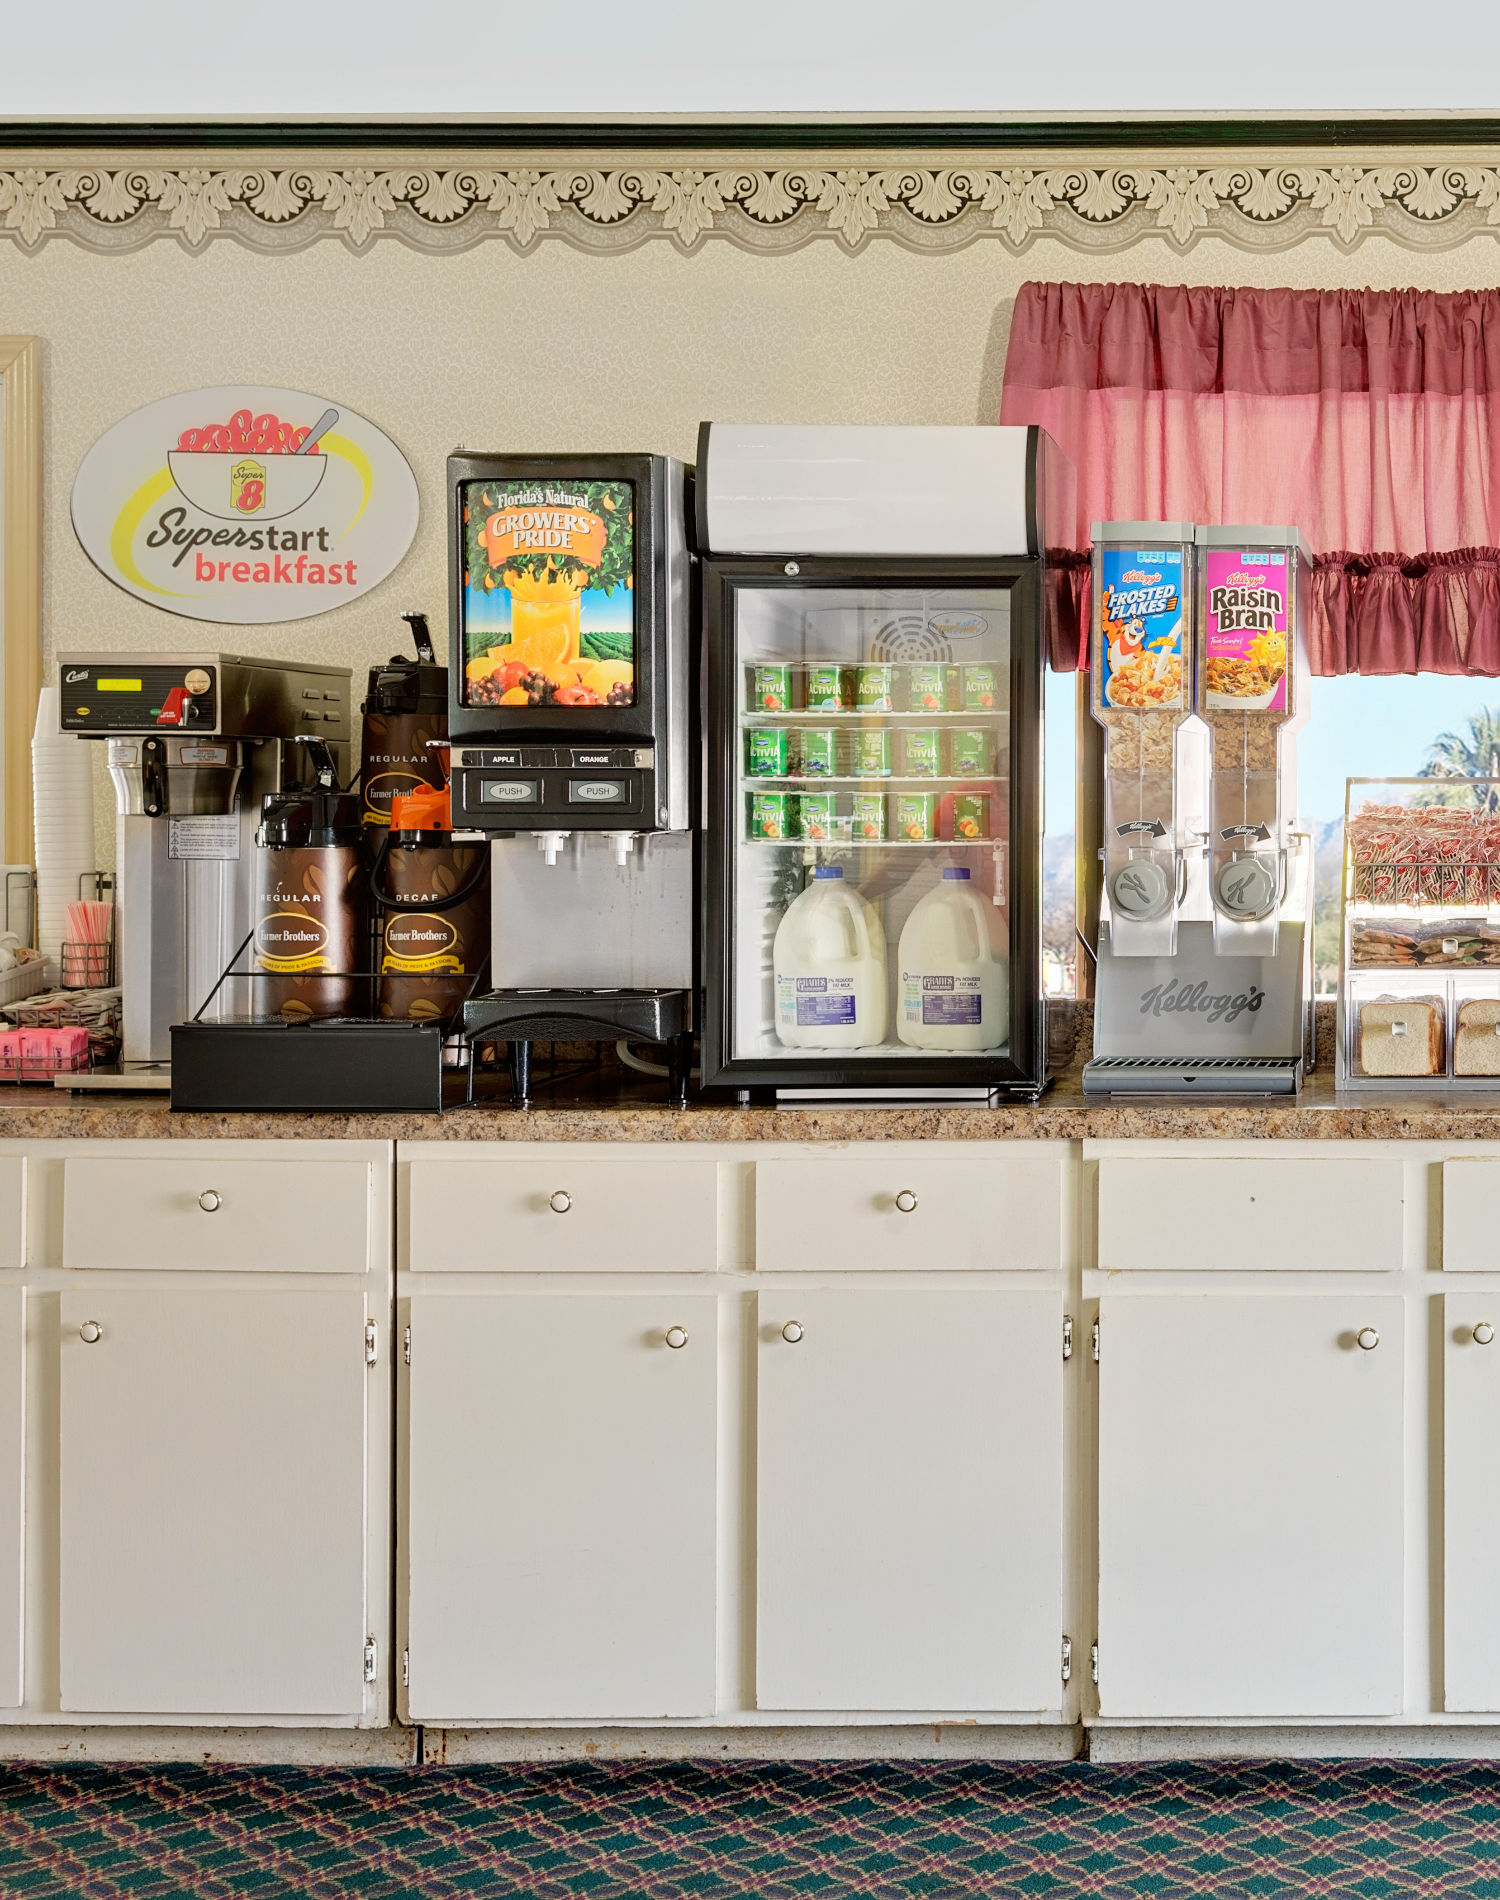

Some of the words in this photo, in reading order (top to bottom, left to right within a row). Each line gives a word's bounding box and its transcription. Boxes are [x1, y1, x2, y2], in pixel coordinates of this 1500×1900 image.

[233, 467, 264, 479] Super
[237, 480, 264, 510] 8
[497, 488, 544, 508] Florida's
[545, 489, 589, 508] Natural
[146, 507, 330, 567] Superstart
[513, 531, 573, 549] PRIDE
[195, 553, 358, 585] breakfast
[1123, 571, 1161, 585] Kellogg's
[1227, 573, 1265, 587] Kellogg's
[1108, 585, 1175, 608] FROSTED
[1212, 586, 1280, 612] Raisin
[1110, 598, 1167, 621] FLAKES
[1220, 608, 1274, 630] Bran
[369, 755, 428, 763] REGULAR
[370, 788, 392, 799] Farmer
[499, 787, 523, 795] PUSH
[586, 787, 610, 795] PUSH
[260, 894, 321, 902] REGULAR
[283, 930, 320, 941] Brothers
[389, 930, 411, 940] Farmer
[411, 930, 447, 940] Brothers
[1140, 978, 1265, 1023] Kellogg's
